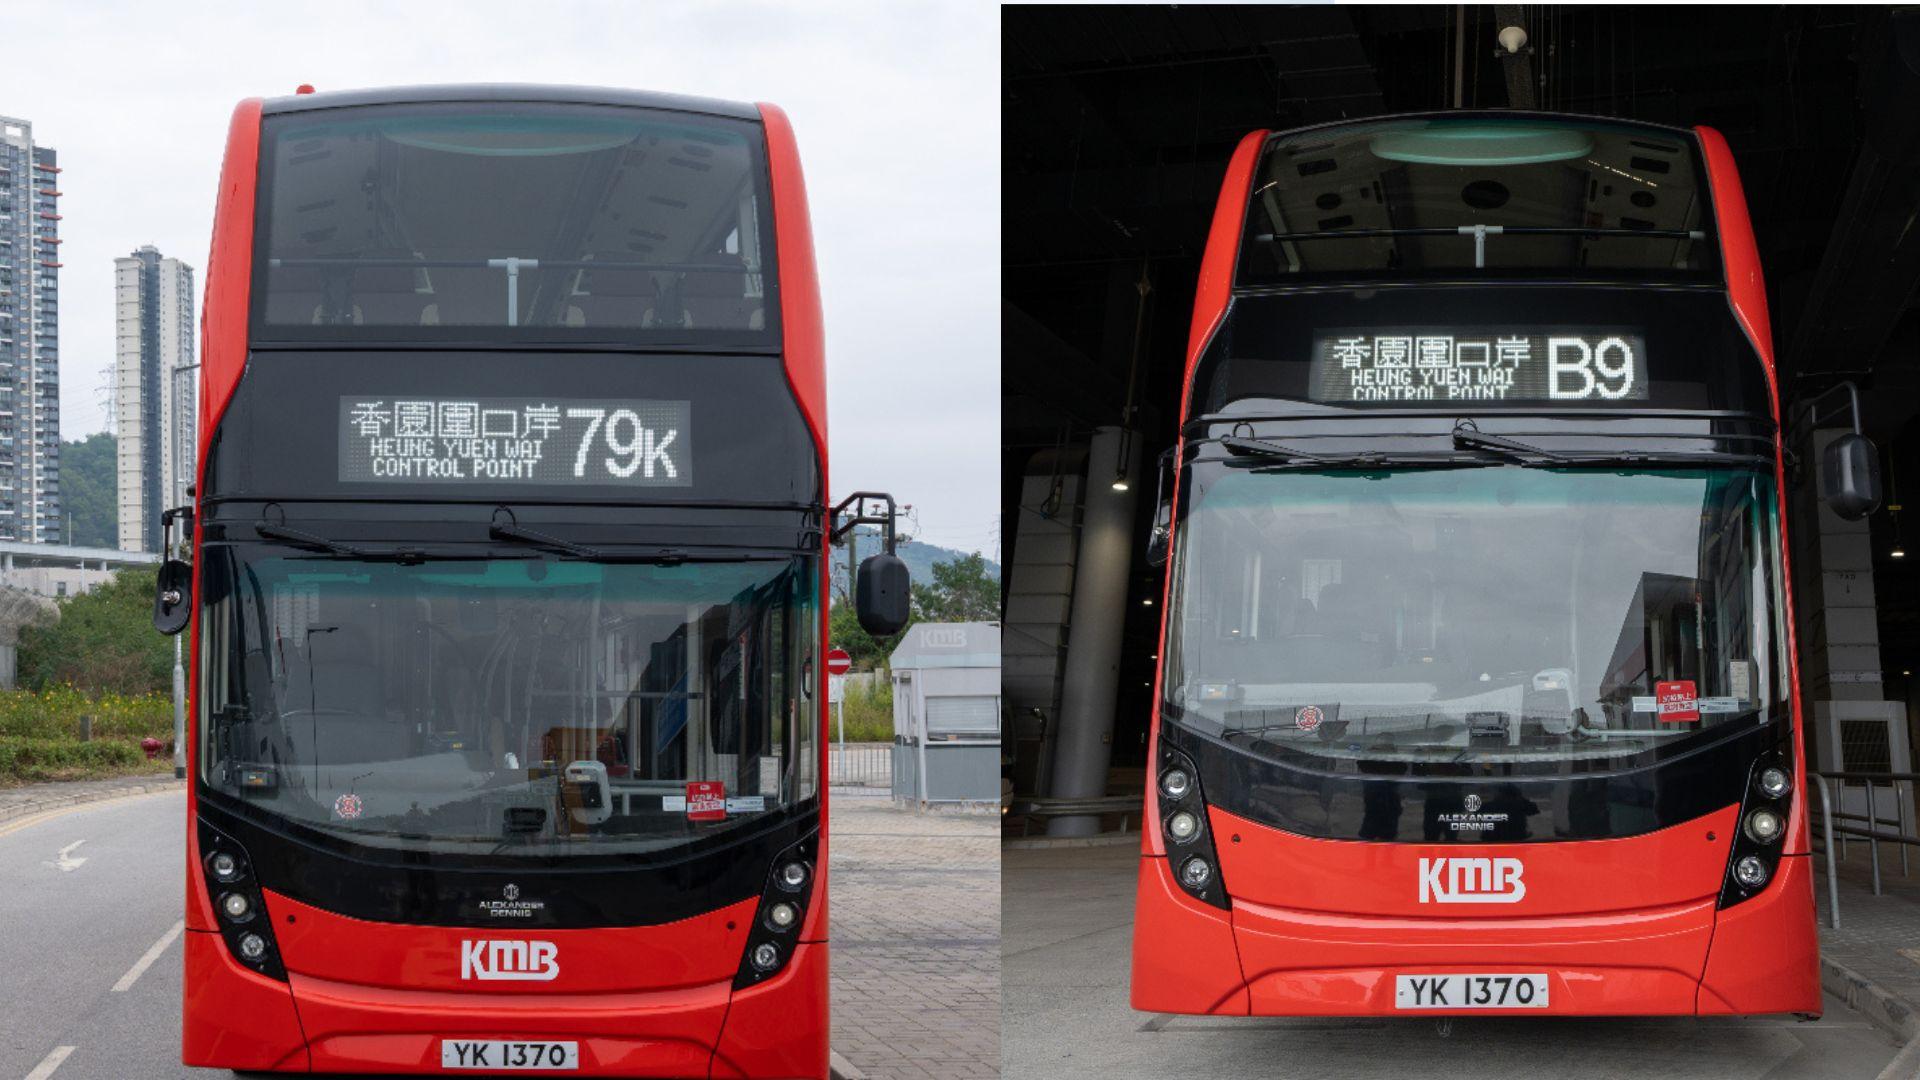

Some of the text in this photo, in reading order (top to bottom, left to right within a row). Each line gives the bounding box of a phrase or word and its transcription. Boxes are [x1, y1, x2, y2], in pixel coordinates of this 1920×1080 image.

[1333, 336, 1531, 369] 香園圍口岸
[1351, 367, 1514, 385] HEUNG YUEN WAI
[1549, 336, 1634, 399] B9
[350, 401, 561, 439] 香園圍口岸
[370, 438, 543, 459] HEUNG YUEN WAI
[567, 408, 677, 478] 79K
[373, 458, 537, 479] CONTROL POINT
[1437, 813, 1508, 822] ALEXANDER
[1451, 822, 1495, 831] DENNIS
[1418, 857, 1526, 903] KMB
[479, 901, 544, 909] ALEXANDER
[490, 909, 532, 917] DENNIS
[461, 940, 560, 981] KMB
[1410, 977, 1534, 1005] YK 1370
[453, 1043, 566, 1067] YK 1370
